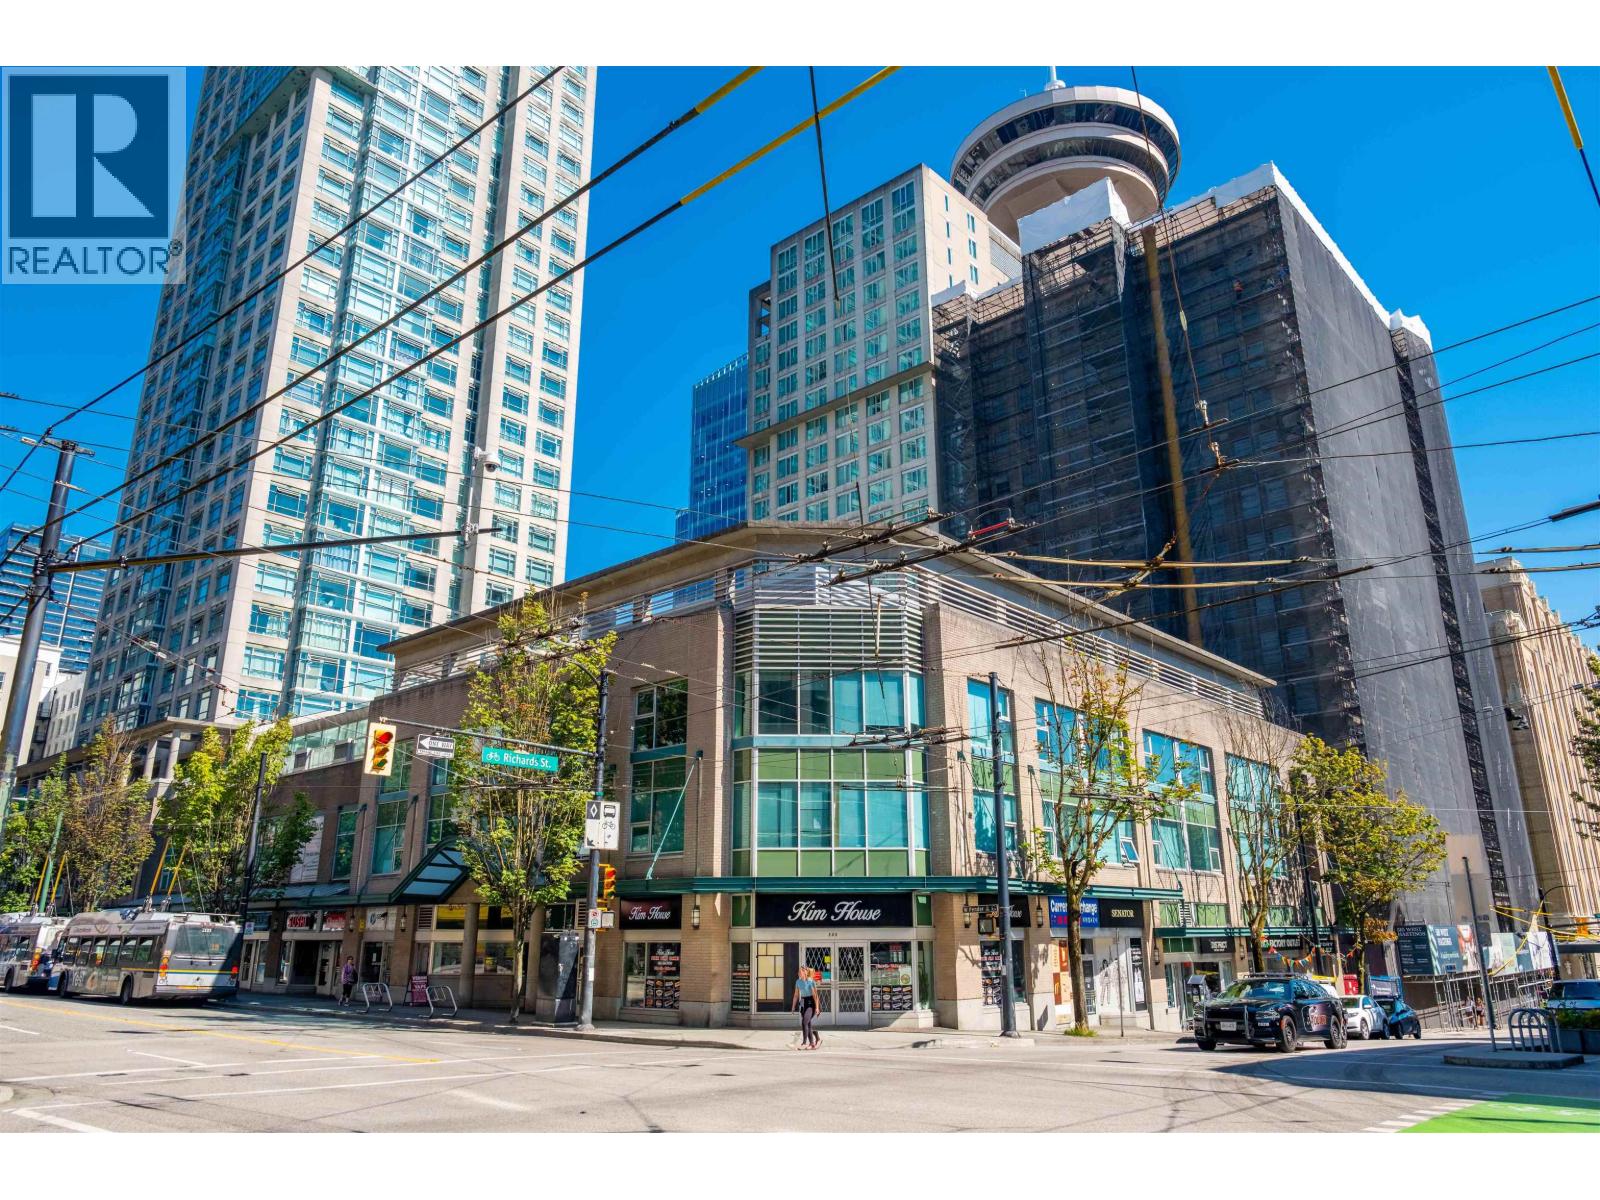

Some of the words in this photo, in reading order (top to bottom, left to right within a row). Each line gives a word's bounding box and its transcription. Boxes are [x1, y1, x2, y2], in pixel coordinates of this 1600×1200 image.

[503, 753, 539, 767] Richards
[540, 758, 552, 769] St.
[628, 905, 647, 920] Kim
[647, 905, 671, 920] House
[788, 900, 828, 921] Kim
[831, 900, 881, 921] House
[1111, 909, 1134, 918] SENATOR
